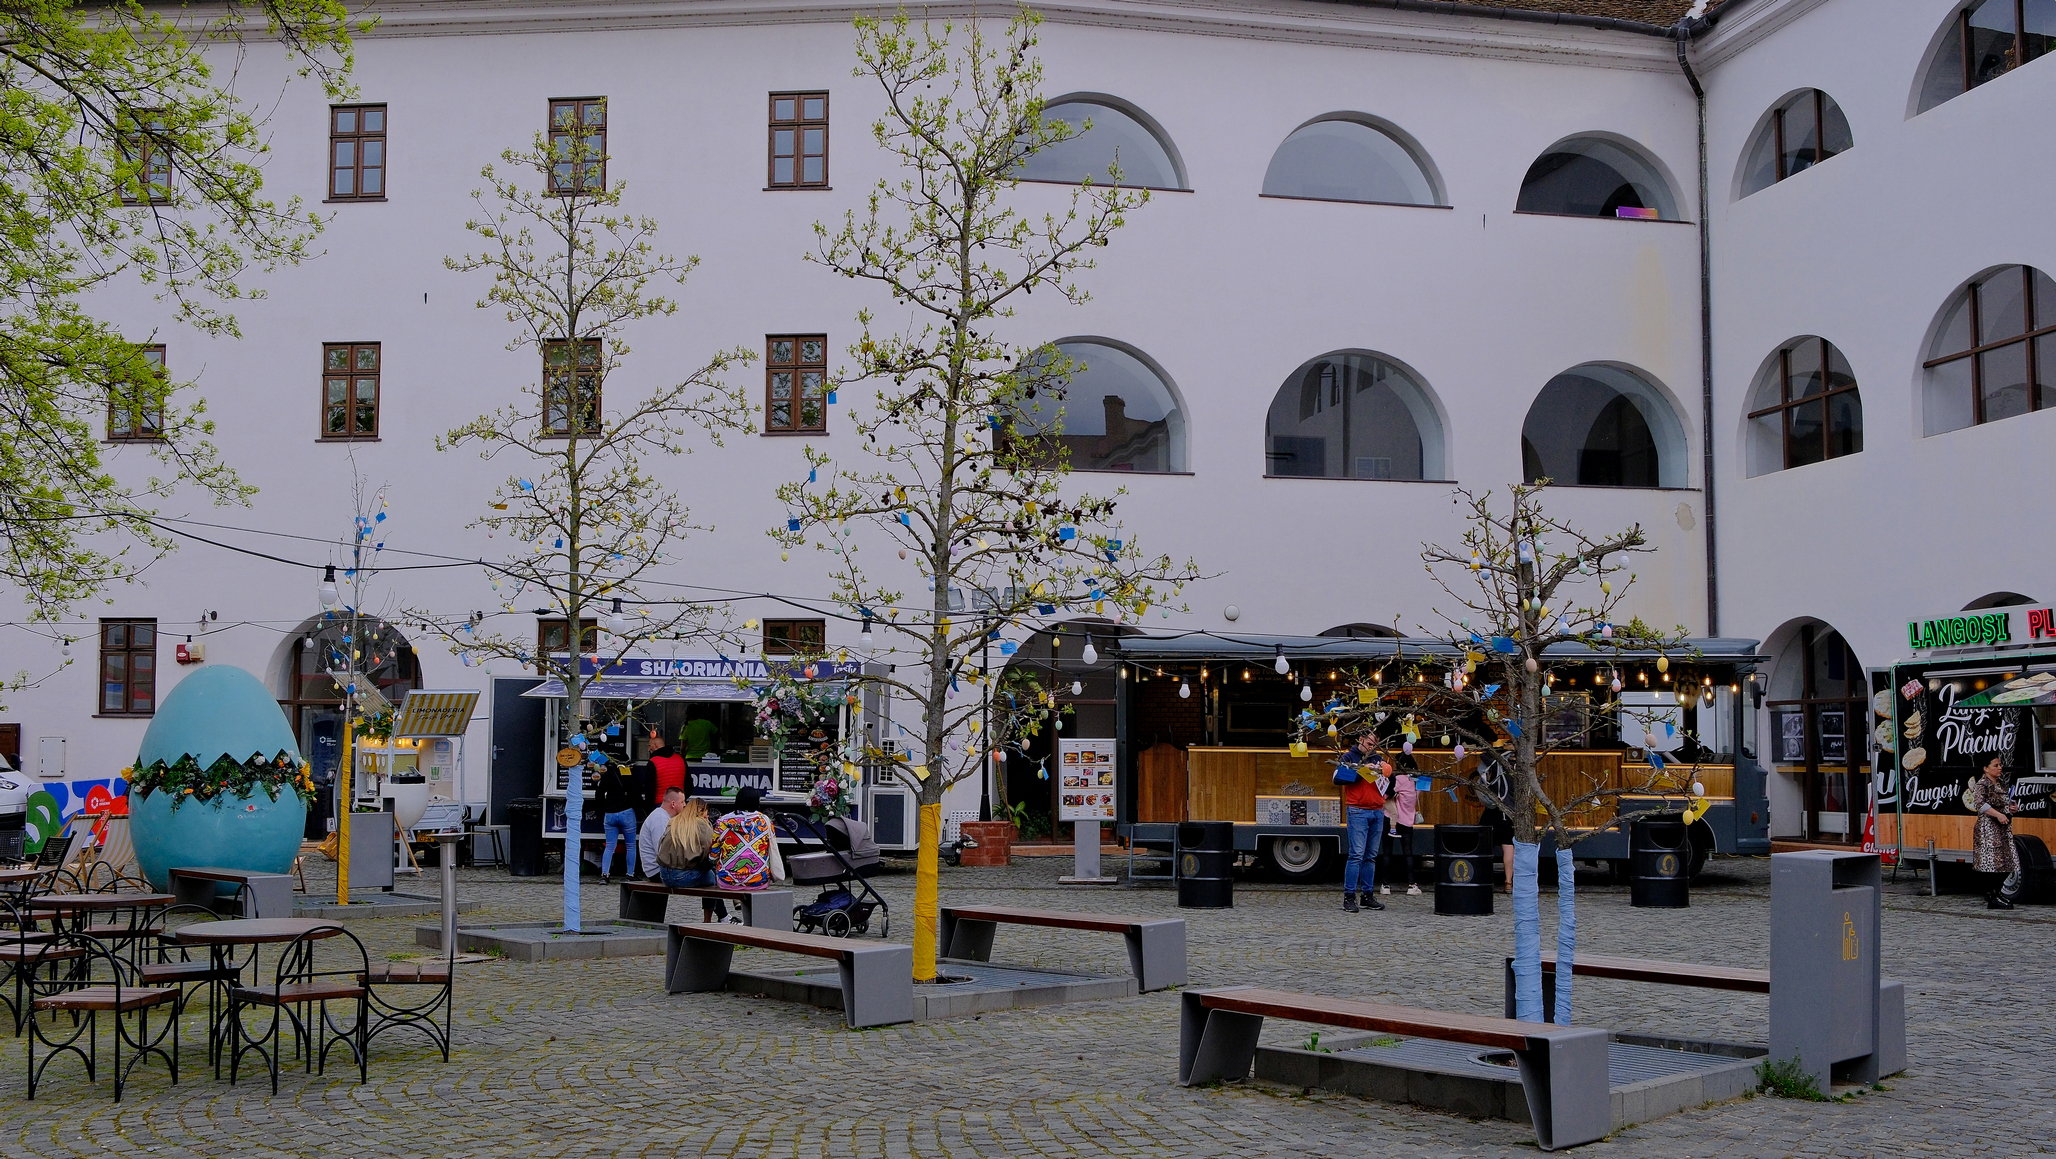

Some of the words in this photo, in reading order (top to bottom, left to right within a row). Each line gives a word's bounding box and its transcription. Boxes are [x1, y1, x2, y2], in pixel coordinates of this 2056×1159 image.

[640, 661, 769, 677] SHAORMANIA
[1936, 719, 2015, 762] Plăcinte
[1905, 776, 1960, 810] Langoși
[2026, 798, 2047, 811] casă
